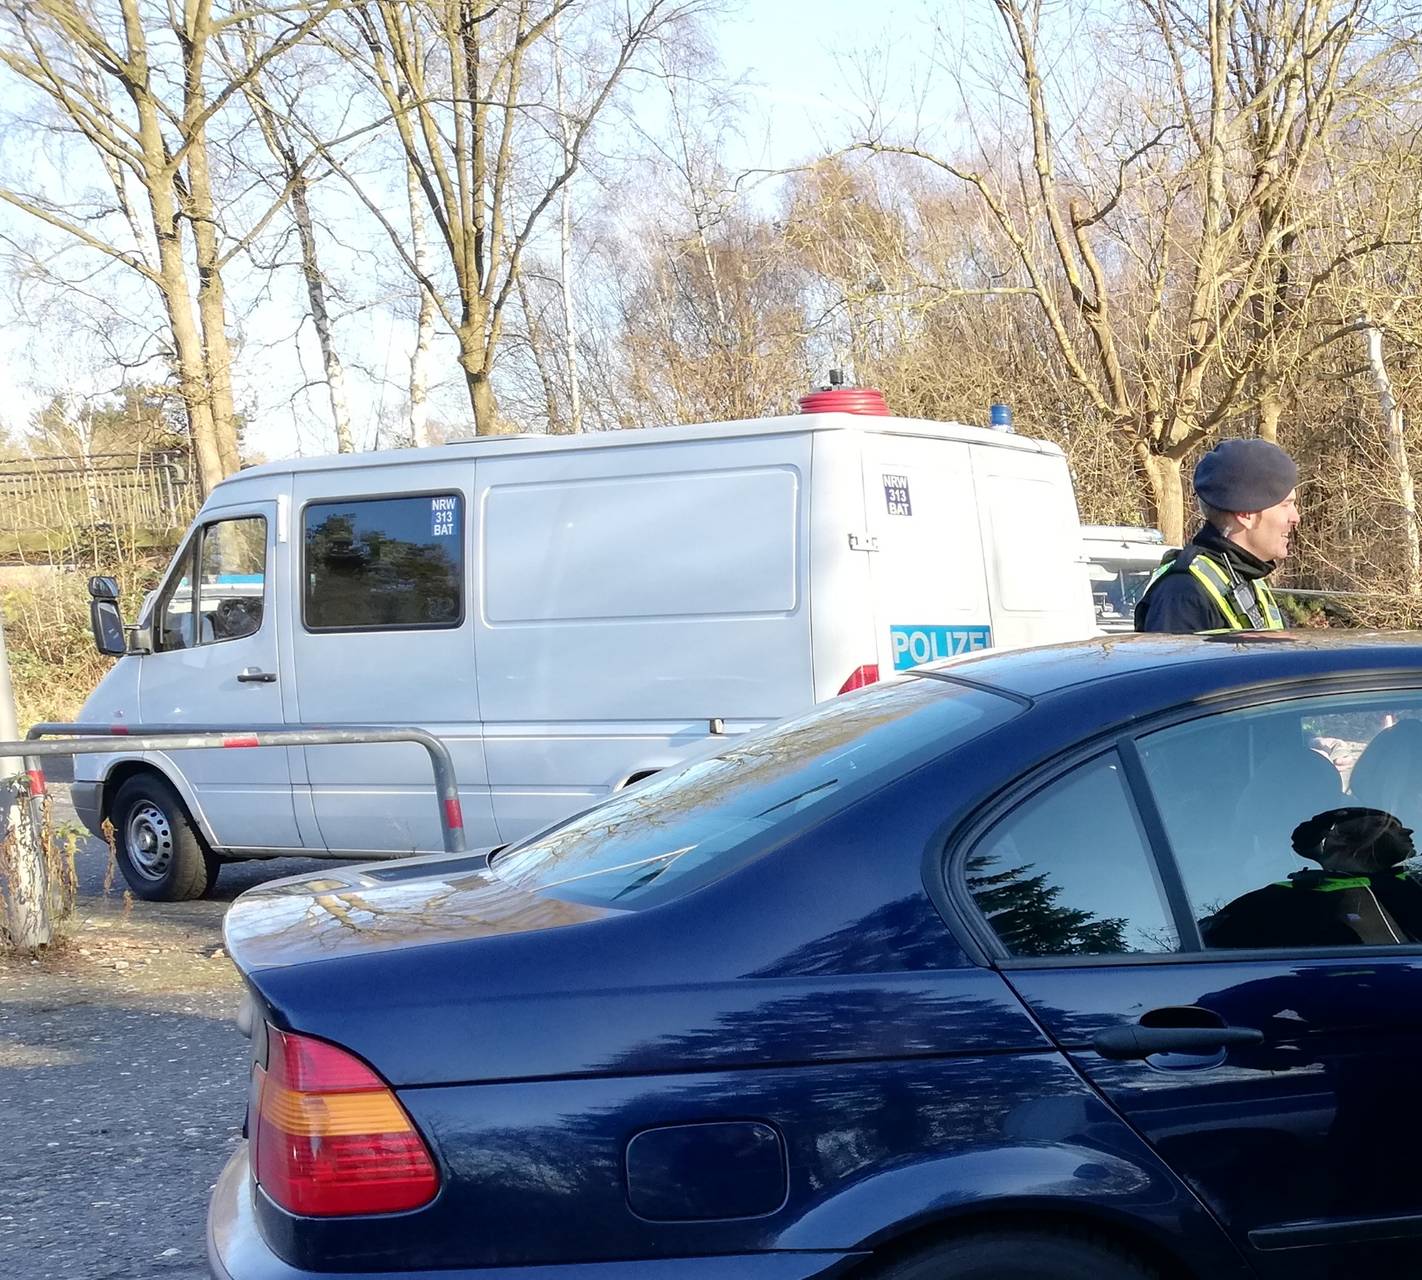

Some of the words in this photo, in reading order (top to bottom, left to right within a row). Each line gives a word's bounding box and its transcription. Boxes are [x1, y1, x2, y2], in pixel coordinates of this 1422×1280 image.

[883, 475, 907, 489] NRW
[888, 489, 907, 502] 313
[432, 498, 456, 510] NRW
[889, 502, 909, 516] BAT
[436, 511, 453, 523] 313
[434, 524, 454, 536] BAT
